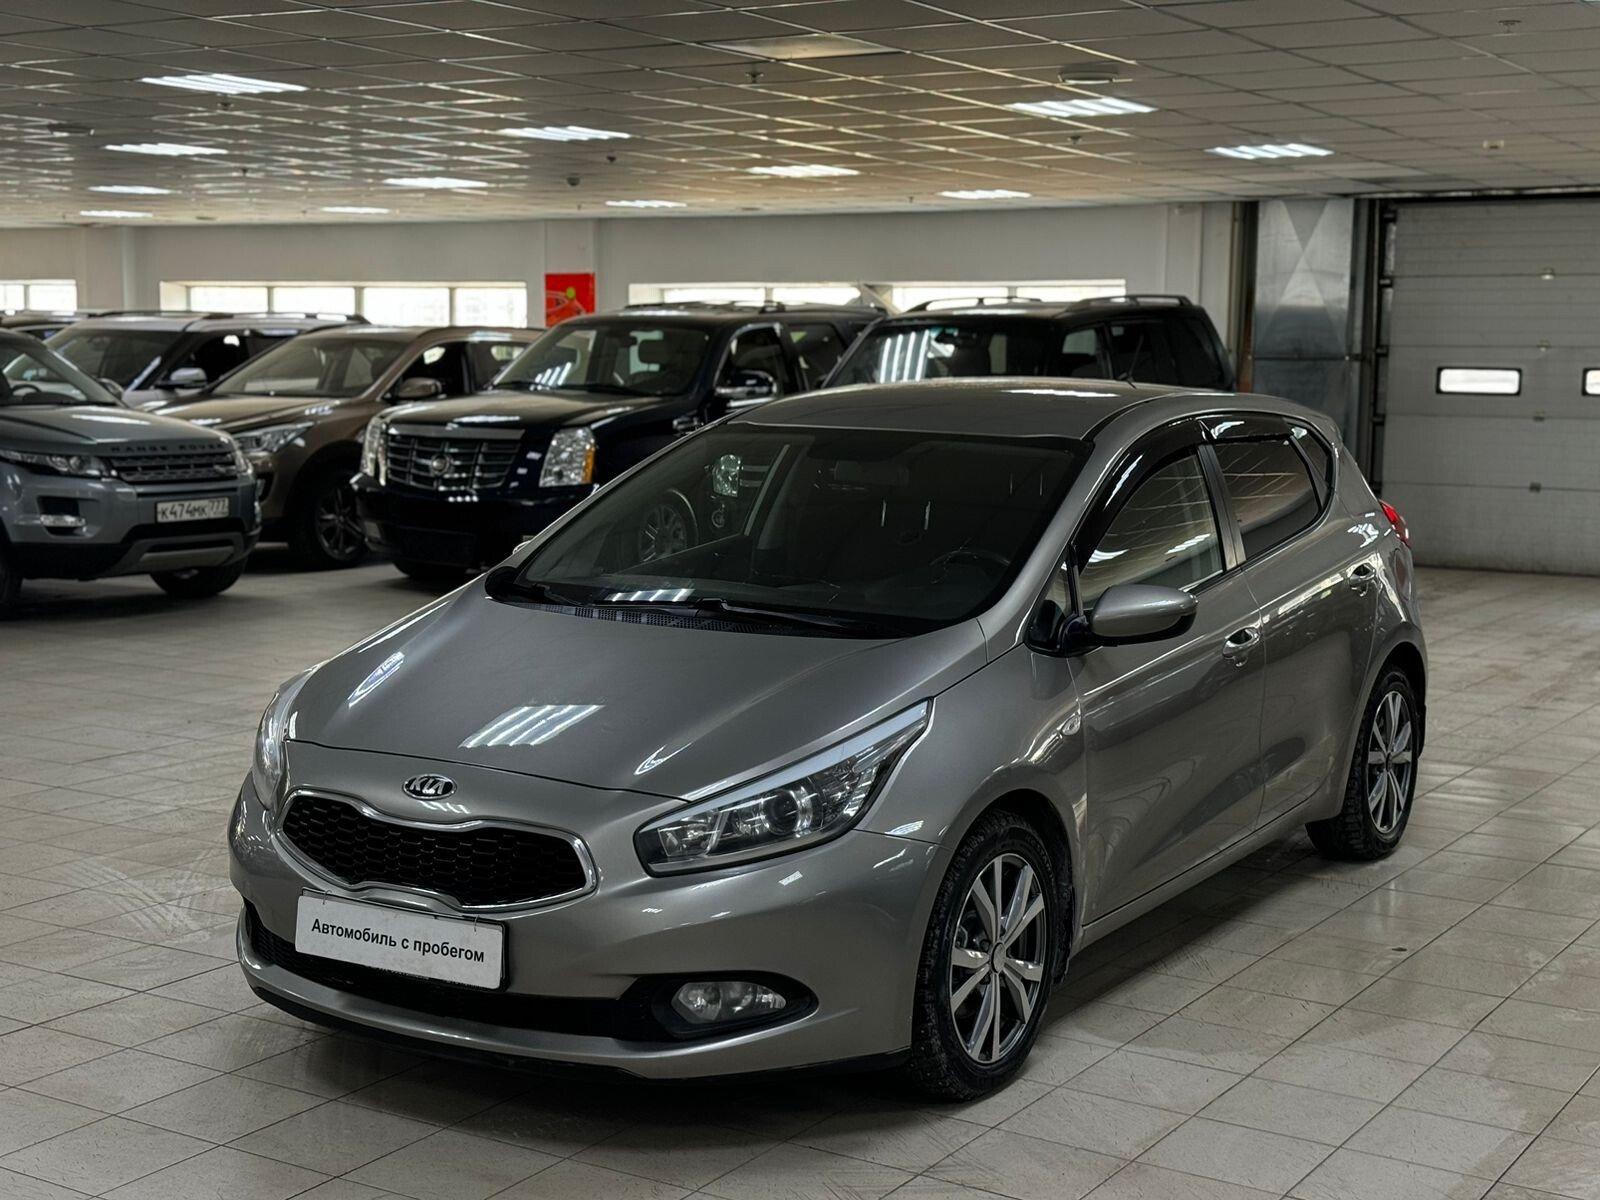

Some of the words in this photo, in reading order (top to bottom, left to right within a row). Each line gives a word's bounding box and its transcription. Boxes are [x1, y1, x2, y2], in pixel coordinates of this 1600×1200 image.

[409, 777, 446, 795] KIA
[311, 918, 397, 947] Автомобиль
[401, 938, 410, 950] с
[413, 940, 485, 963] пробегом
